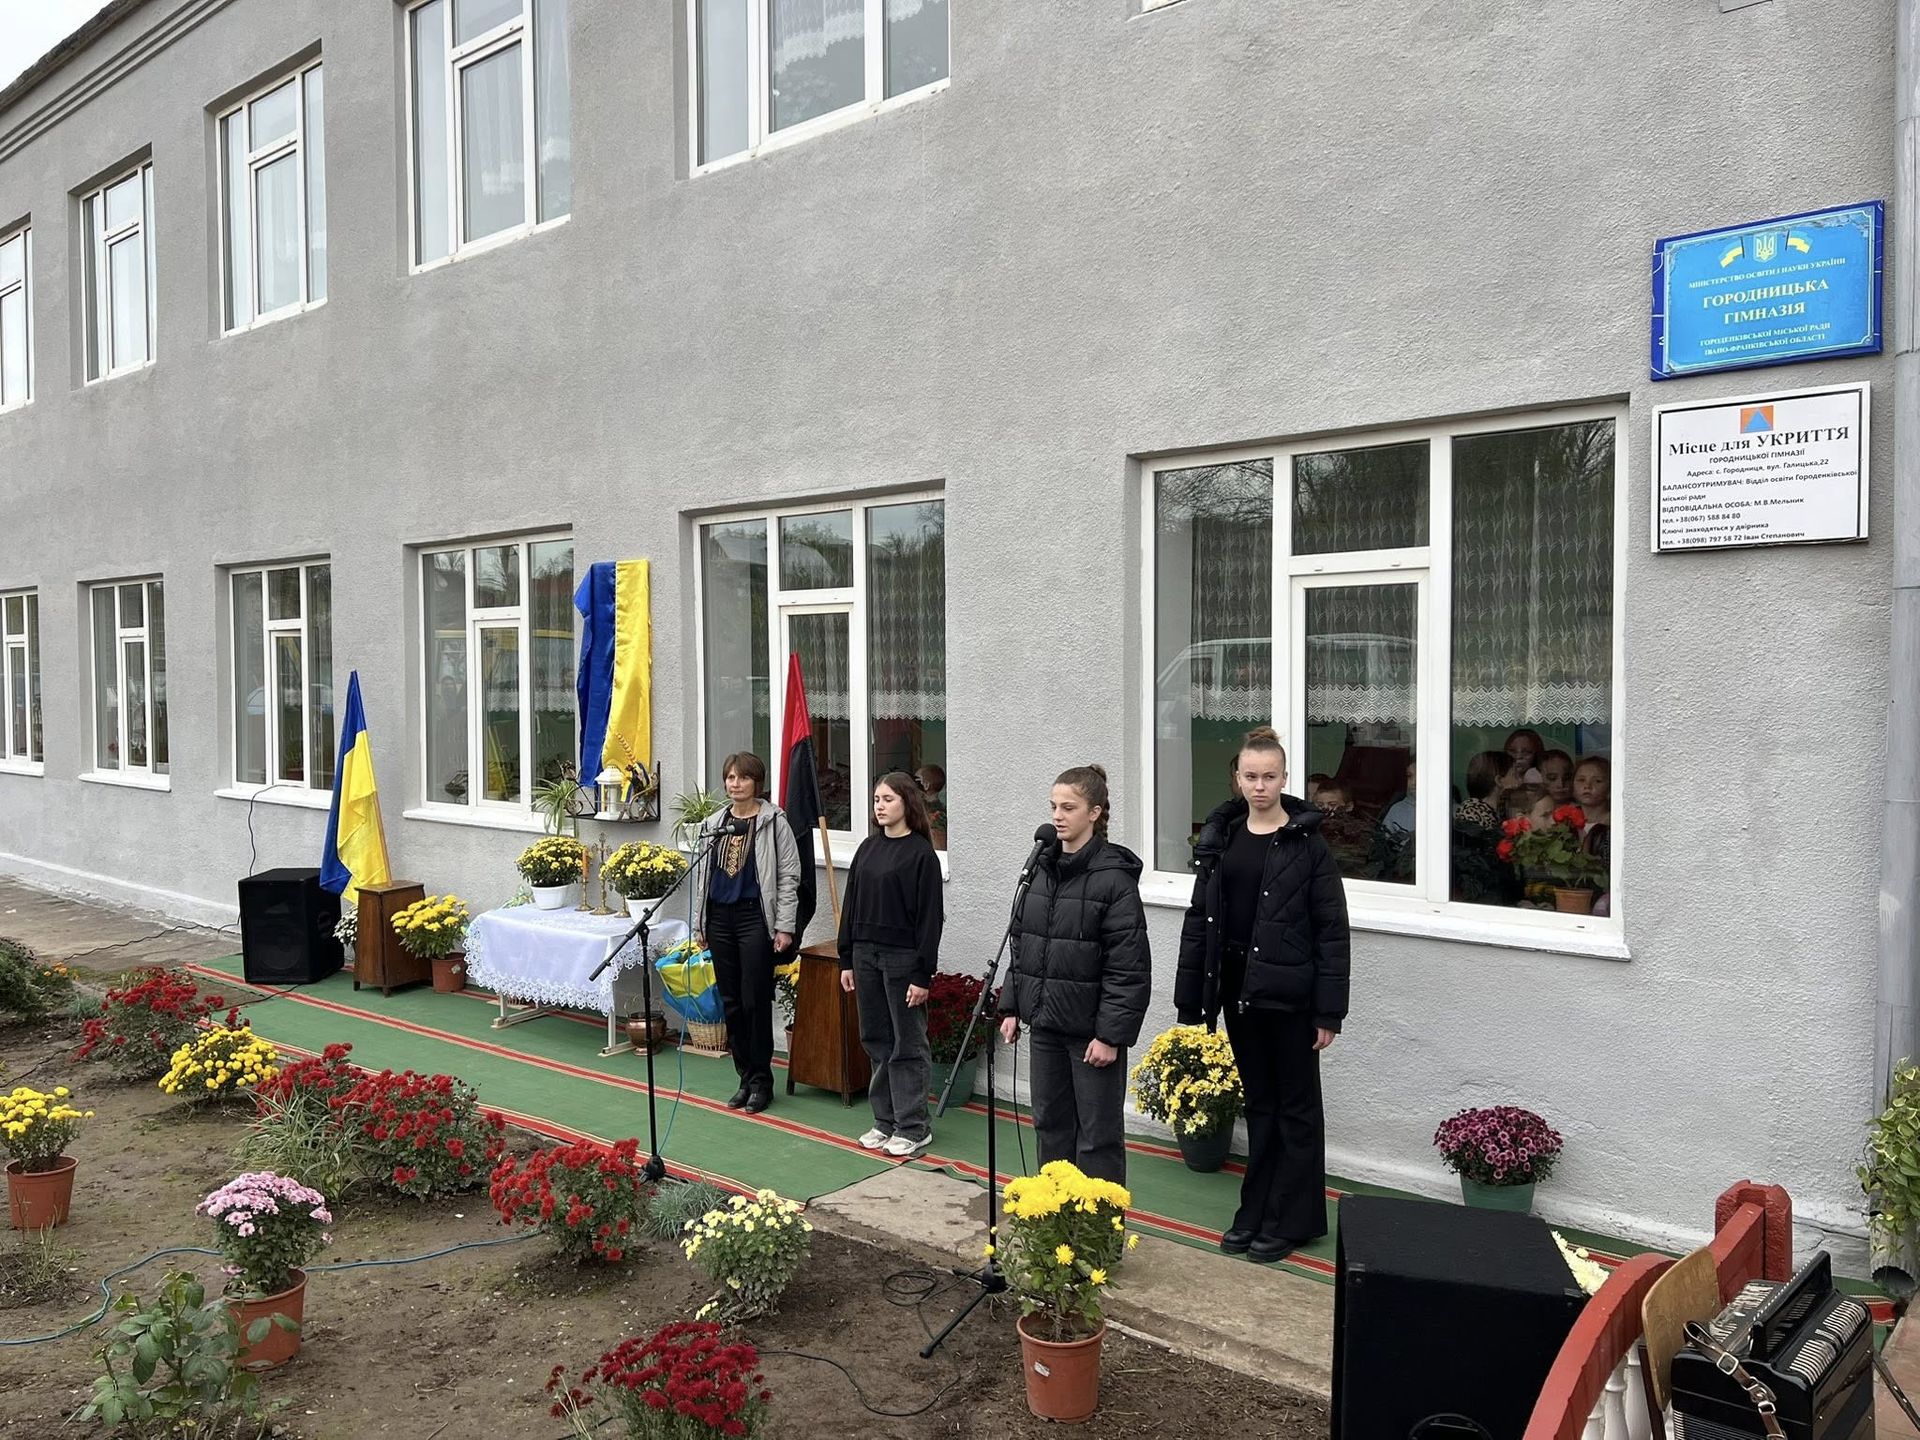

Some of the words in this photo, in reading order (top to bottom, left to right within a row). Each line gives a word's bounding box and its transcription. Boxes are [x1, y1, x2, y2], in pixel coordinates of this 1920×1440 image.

[1689, 273, 1745, 289] МІНІСТЕРСТВО
[1745, 268, 1776, 280] ОСВІТИ
[1781, 263, 1809, 274] НАУКИ
[1810, 257, 1846, 269] УКРАЇНИ
[1702, 279, 1829, 309] ГОРОДНИЦЬКА
[1723, 302, 1806, 325] ГІМНАЗІЯ
[1700, 330, 1773, 347] ГОРОДЕНКІВСЬКОЇ
[1773, 324, 1808, 337] МІСЬКОЇ
[1809, 322, 1831, 332] РАДИ
[1704, 337, 1788, 356] ІВАНО-ФРАНКІВСЬКОЇ
[1789, 333, 1825, 344] ОБЛАСТІ
[1669, 442, 1717, 456] Місце
[1720, 440, 1750, 452] для
[1757, 426, 1849, 448] УКРИТТЯ
[1709, 451, 1769, 464] ГОРОДНИЦЬКОЇ
[1770, 448, 1805, 459] ГІМНАЗІЇ
[1687, 469, 1715, 478] Адреса:
[1723, 465, 1764, 475] Городниця,
[1766, 463, 1781, 472] вул.
[1662, 478, 1744, 492] БАЛАНСОУТРИМУВАЧ:
[1745, 476, 1769, 486] Відділ
[1770, 474, 1794, 484] освіти
[1795, 470, 1858, 482] Городенківської
[1662, 494, 1688, 503] міської
[1688, 494, 1706, 502] ради
[1662, 502, 1723, 513] ВІДПОВІДАЛЬНА
[1725, 501, 1753, 510] ОСОБА:
[1731, 512, 1741, 520] 80
[1662, 527, 1684, 535] Ключі
[1735, 522, 1769, 531] двірника
[1709, 535, 1722, 543] 797
[1723, 534, 1732, 542] 58
[1733, 533, 1743, 541] 72
[1760, 532, 1805, 540] Степанович
